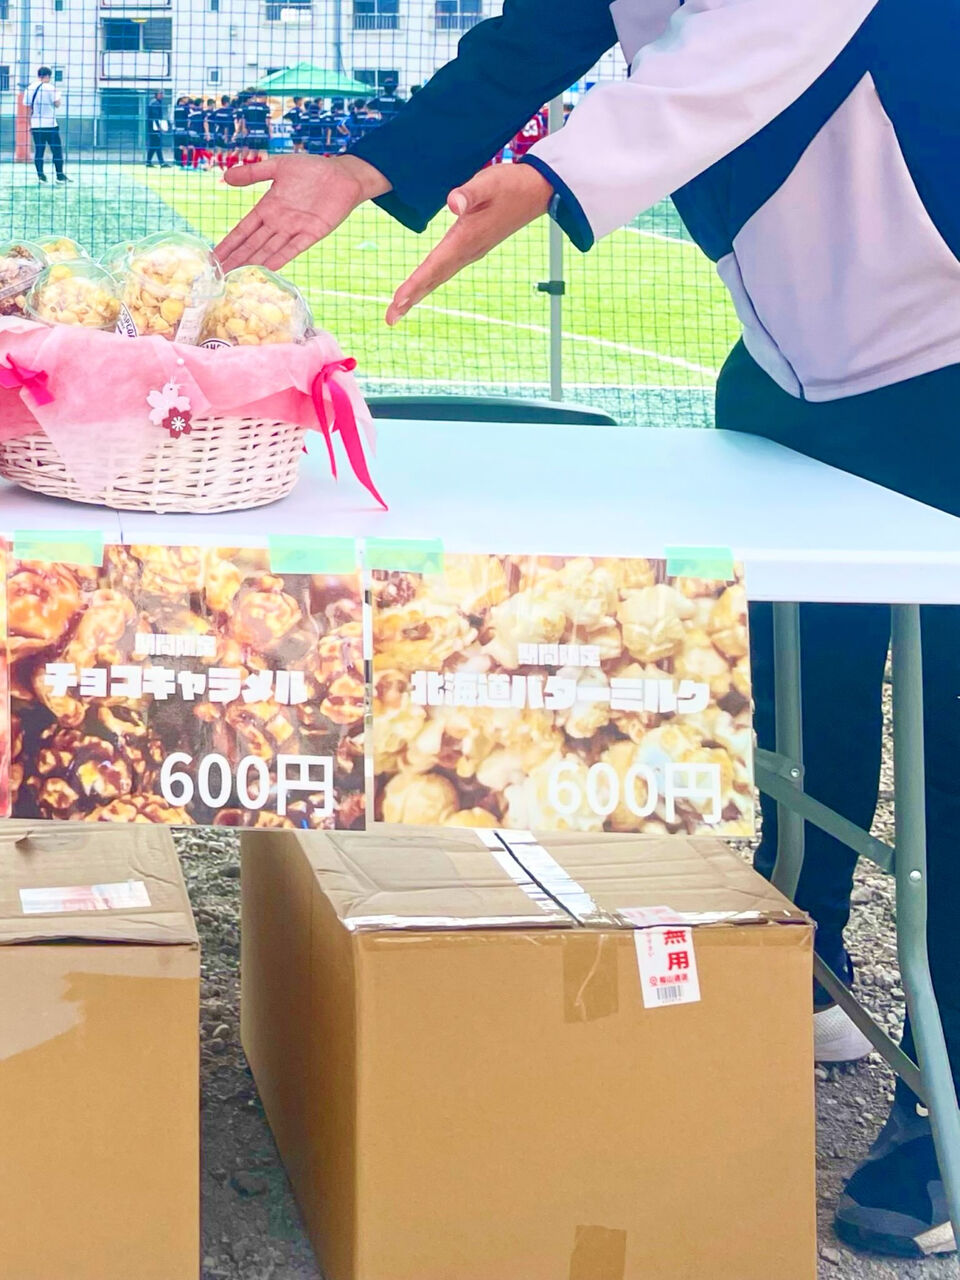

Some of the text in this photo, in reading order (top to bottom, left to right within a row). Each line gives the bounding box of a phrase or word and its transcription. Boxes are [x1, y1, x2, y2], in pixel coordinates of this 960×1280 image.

[43, 662, 309, 706] チョコキャラメル
[410, 670, 711, 714] 北海道バターミルク
[159, 751, 335, 818] 600円
[545, 760, 723, 825] 600円
